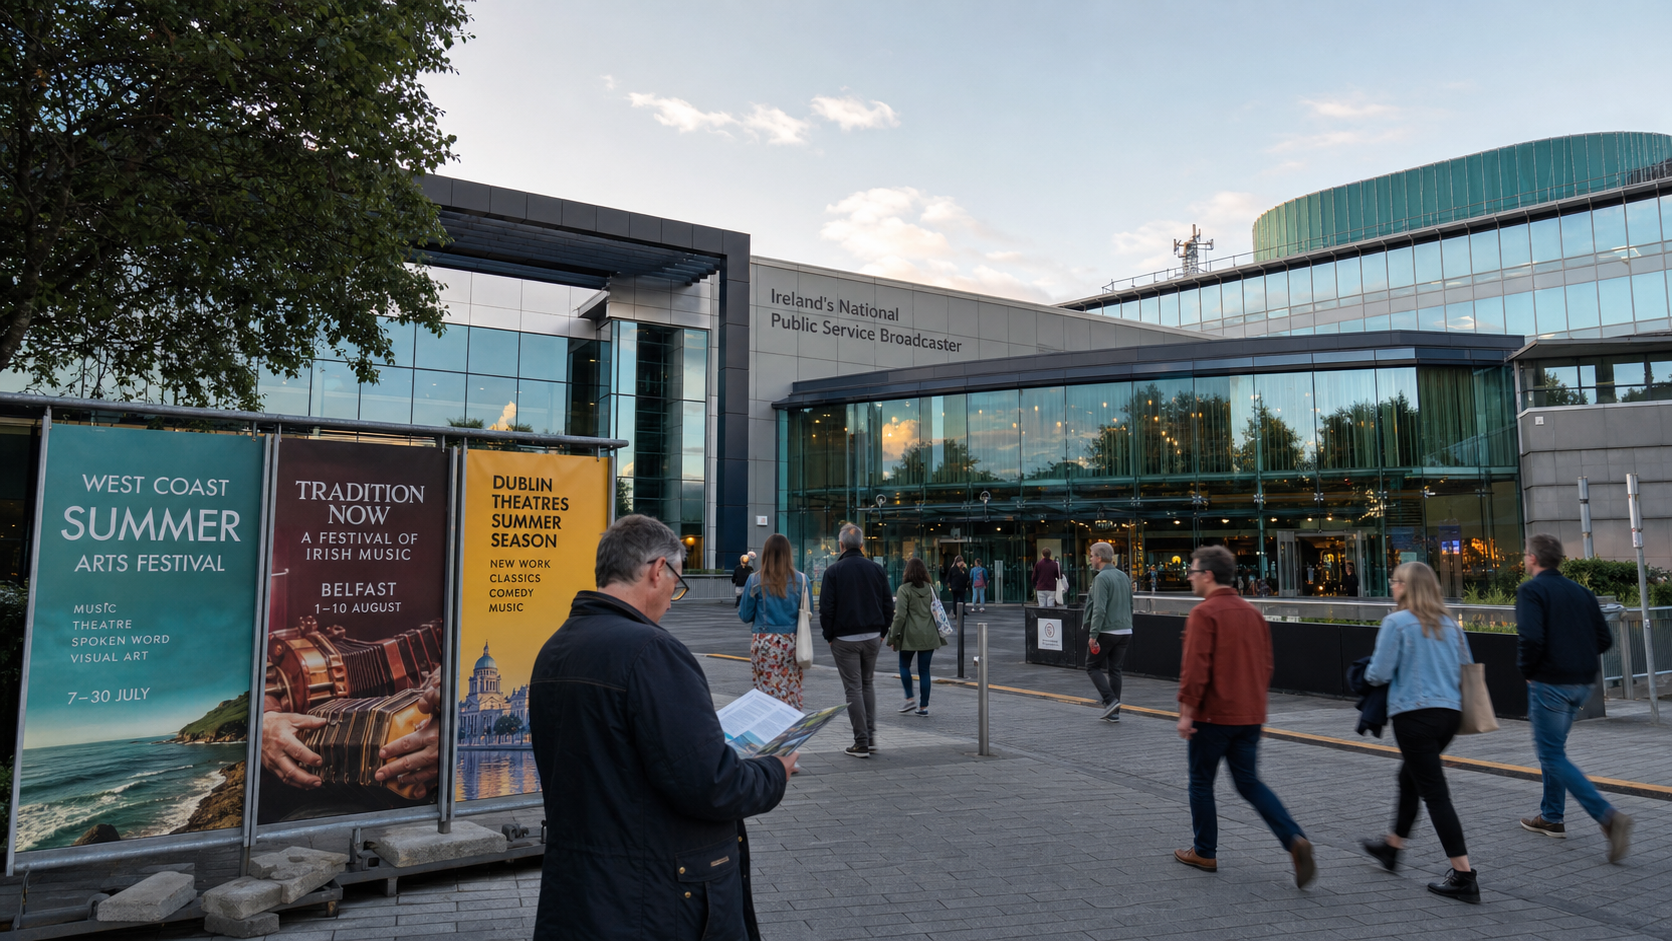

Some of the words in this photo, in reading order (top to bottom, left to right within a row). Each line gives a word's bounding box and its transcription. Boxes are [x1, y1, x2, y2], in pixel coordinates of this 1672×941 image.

[771, 288, 834, 312] Ireland's
[839, 299, 899, 321] National
[771, 312, 818, 333] Public
[822, 320, 875, 341] Service
[880, 328, 962, 353] Broadcaster
[82, 474, 145, 493] WEST
[153, 476, 229, 496] COAST
[493, 475, 553, 492] DUBLIN
[295, 480, 425, 504] TRADITION
[491, 494, 570, 511] THEATRES
[328, 504, 391, 525] NOW
[491, 513, 562, 530] SUMMER
[61, 505, 241, 542] SUMMER
[300, 532, 312, 544] A
[319, 532, 392, 545] FESTIVAL
[398, 533, 418, 545] OF
[490, 533, 557, 548] SEASON
[306, 548, 352, 560] IRISH
[359, 548, 411, 561] MUSIC
[74, 554, 129, 572] ARTS
[137, 554, 225, 572] FESTIVAL
[490, 559, 515, 569] NEW
[518, 559, 551, 569] WORK
[489, 573, 541, 583] CLASSICS
[321, 582, 397, 597] BELFAST
[489, 588, 534, 598] COMEDY
[73, 602, 117, 614] MUSIC
[351, 602, 402, 613] AUGUST
[488, 602, 524, 613] MUSIC
[72, 619, 132, 631] THEATRE
[71, 636, 126, 647] SPOKEN
[131, 634, 170, 645] WORD
[70, 652, 119, 663] VISUAL
[123, 650, 149, 661] ART
[115, 687, 151, 702] JULY
